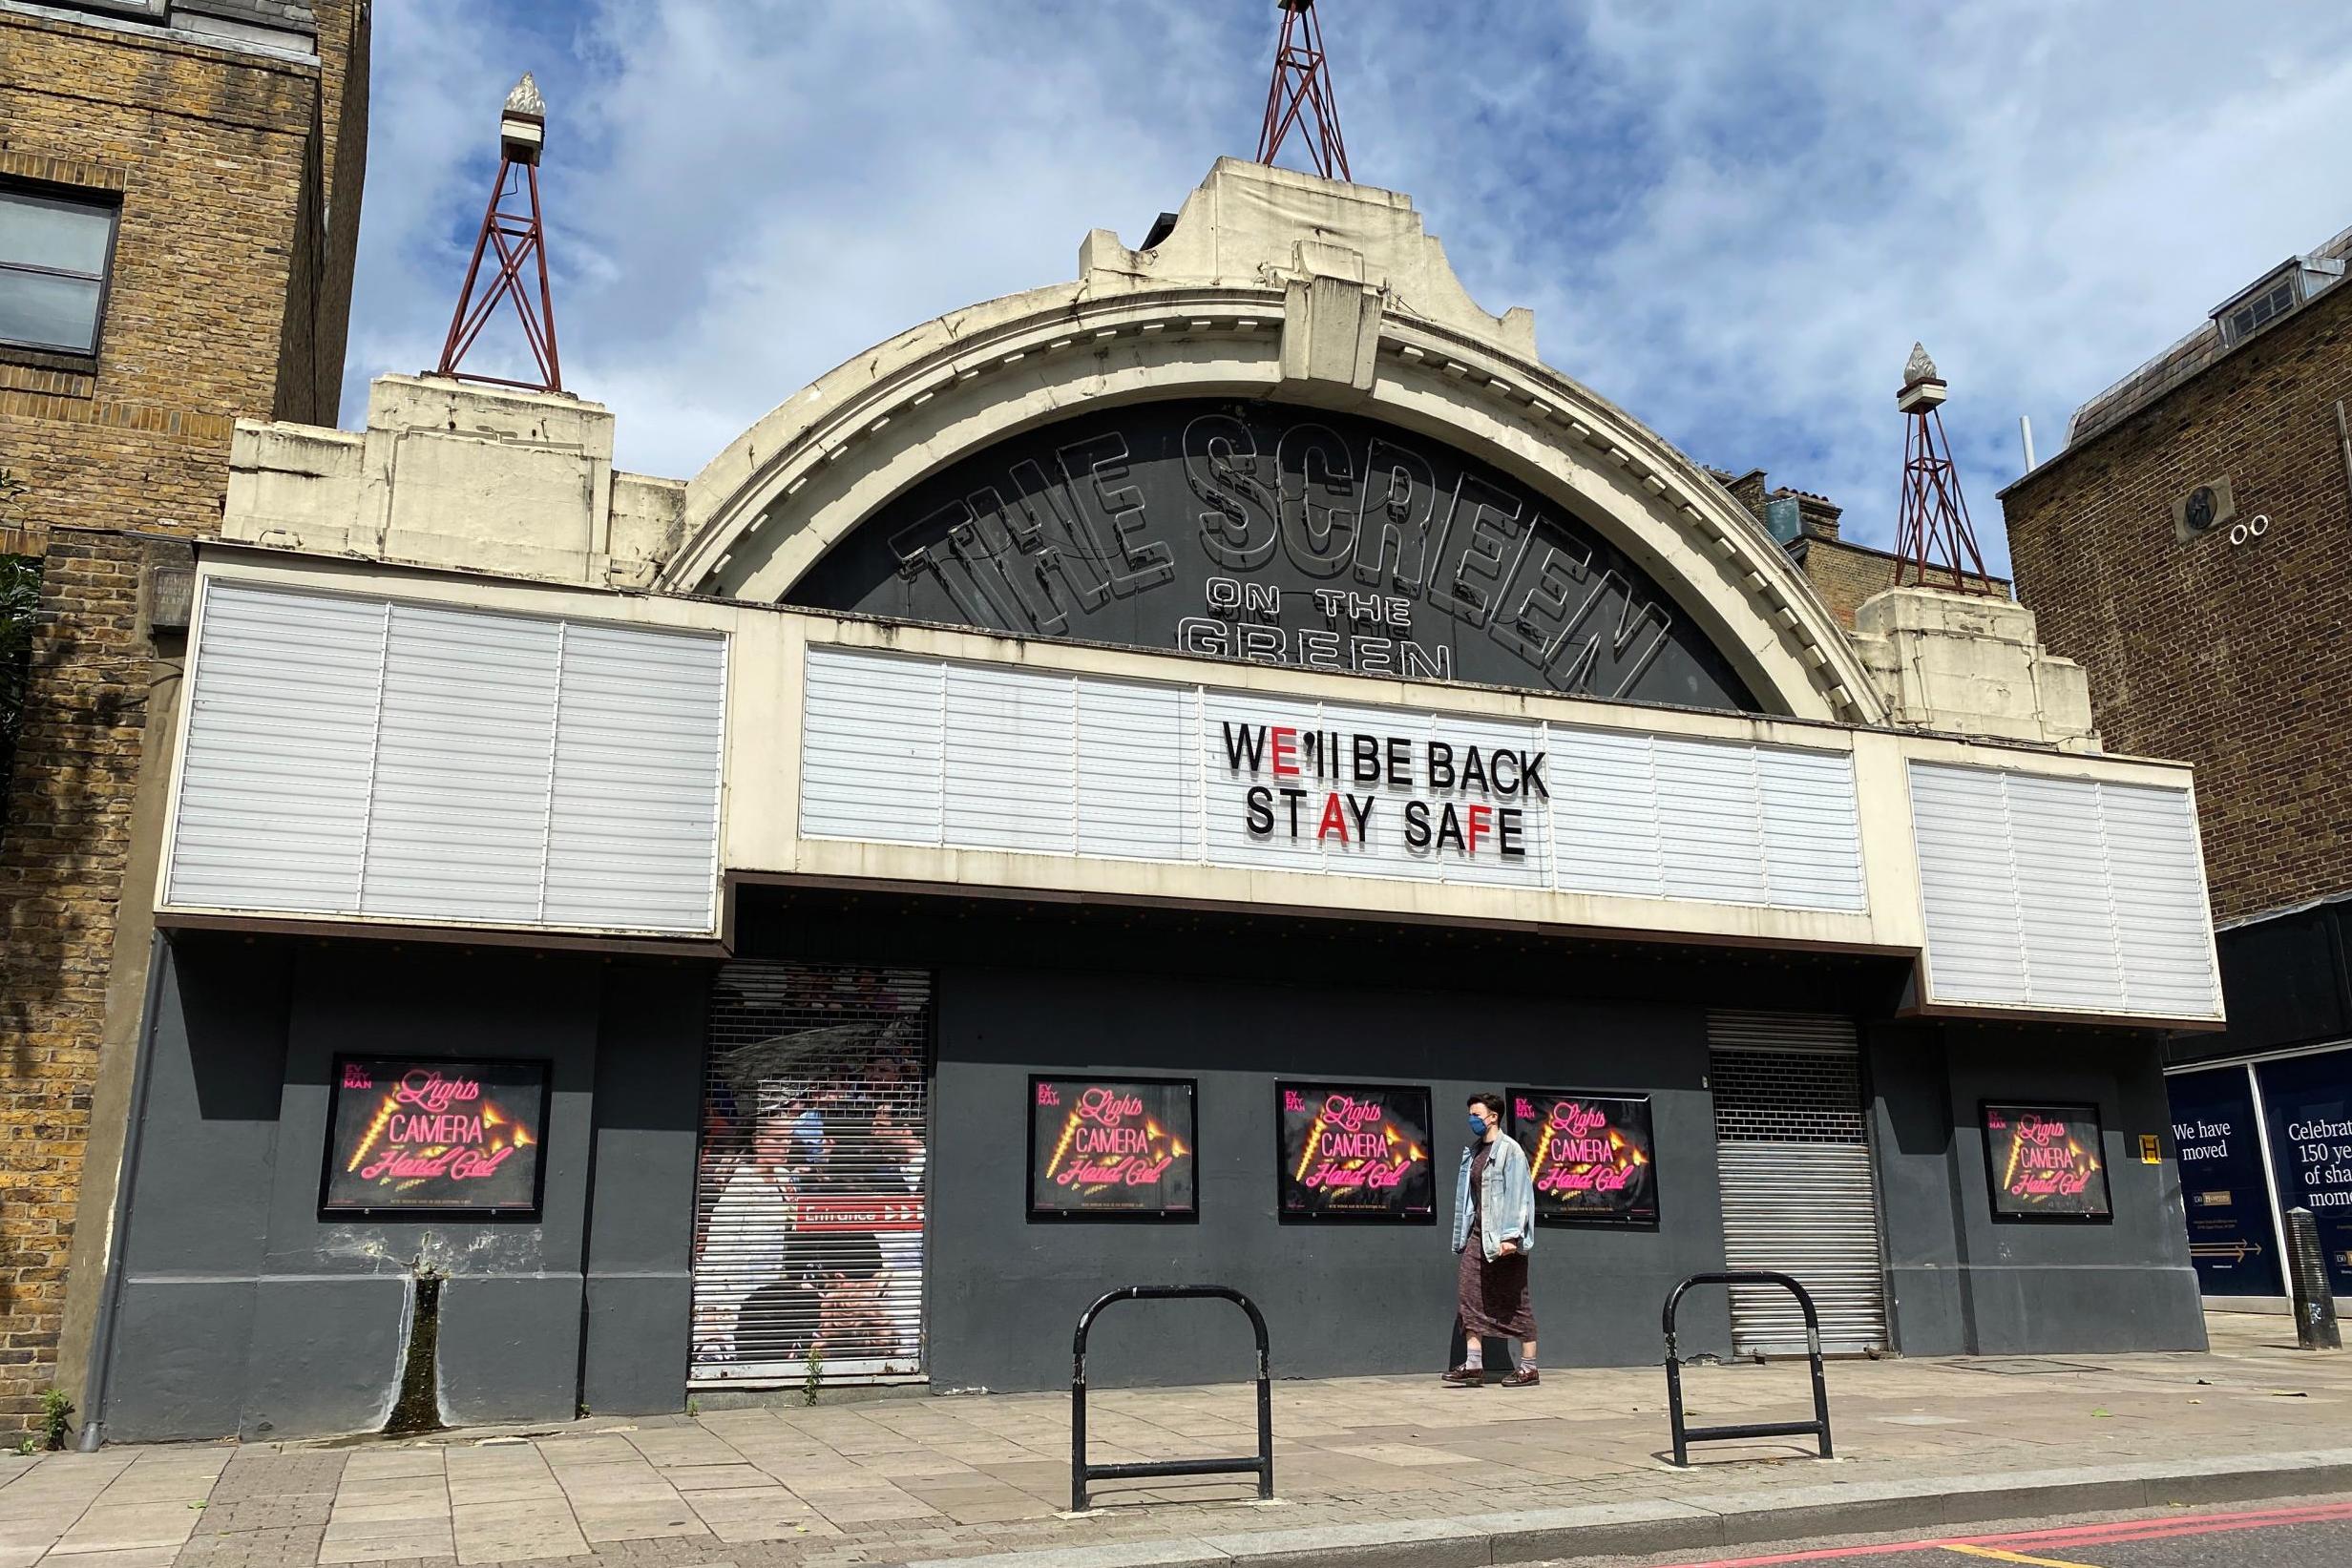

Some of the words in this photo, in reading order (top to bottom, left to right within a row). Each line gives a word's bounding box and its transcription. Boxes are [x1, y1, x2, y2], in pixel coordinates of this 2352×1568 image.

[887, 431, 1174, 632] THE
[1182, 413, 1671, 698] SCREEN
[1207, 577, 1280, 614] ON
[1314, 588, 1412, 626] THE
[1177, 617, 1451, 681] GREEN
[1353, 734, 1414, 785] BE
[1428, 741, 1550, 799] BACK
[1246, 785, 1376, 844] STAY
[1404, 801, 1526, 856] SAFE
[344, 1080, 372, 1089] MAN
[396, 1069, 480, 1113] Lights
[1080, 1088, 1143, 1126] Lights
[1323, 1095, 1381, 1132] Lights
[1551, 1101, 1606, 1139] Lights
[389, 1114, 483, 1144] CAMERA
[1076, 1127, 1148, 1154] CAMERA
[2020, 1114, 2066, 1147] Lights
[2172, 1123, 2195, 1140] We
[2196, 1120, 2232, 1139] have
[1321, 1132, 1389, 1159] CAMERA
[1550, 1138, 1614, 1163] CAMERA
[2020, 1147, 2074, 1169] CAMERA
[2142, 1138, 2159, 1161] H
[2182, 1139, 2228, 1160] moved
[2299, 1142, 2329, 1162] 150
[361, 1146, 466, 1180] Hand
[451, 1147, 514, 1181] Gel
[1057, 1156, 1135, 1184] Hand
[1126, 1156, 1173, 1185] Gel
[1305, 1160, 1377, 1187] Hand
[1368, 1160, 1412, 1188] Gel
[1537, 1163, 1604, 1191] Hand
[1595, 1163, 1636, 1192] Gel
[2304, 1164, 2320, 1185] of
[2011, 1170, 2066, 1195] Hand
[2058, 1170, 2091, 1196] Gel
[805, 1205, 876, 1222] Entrance
